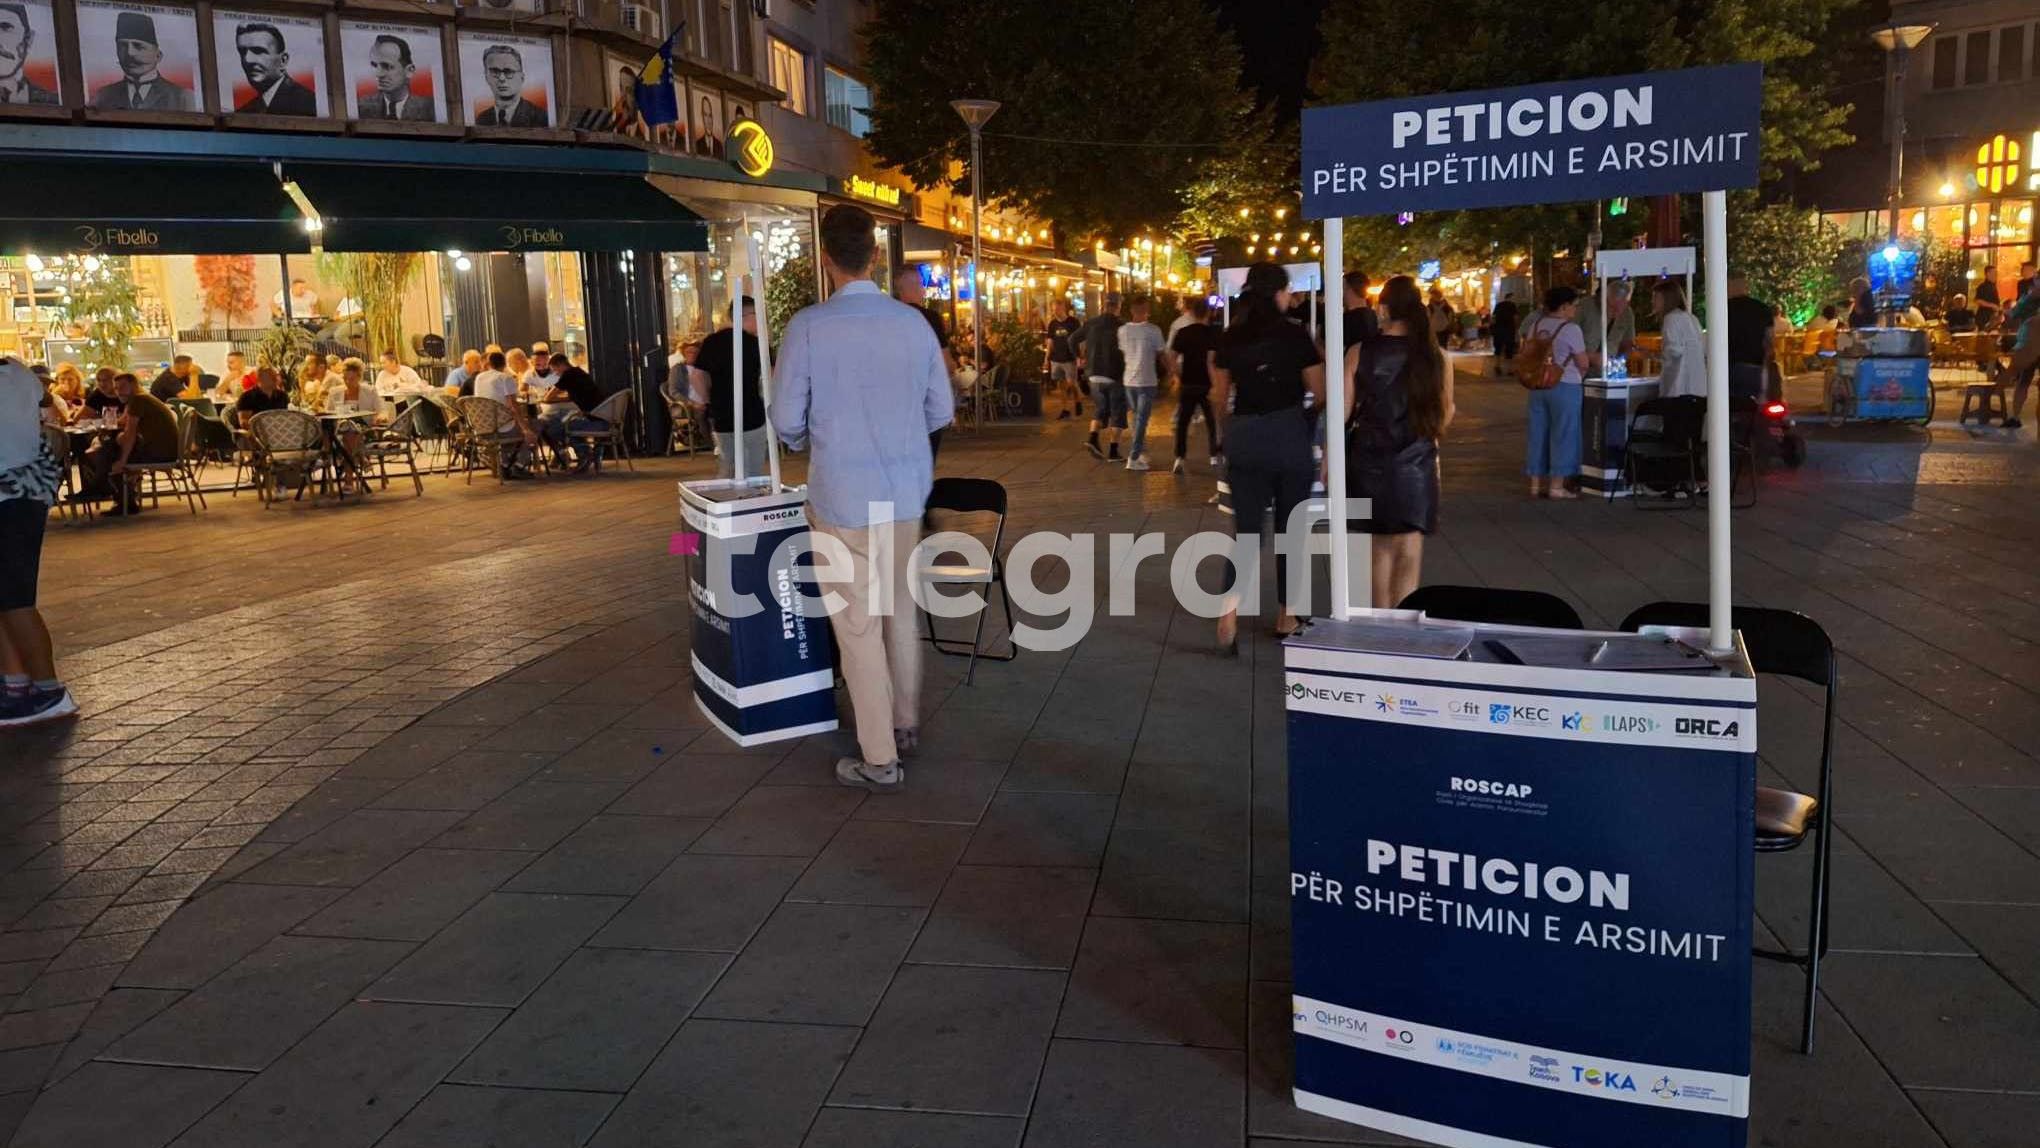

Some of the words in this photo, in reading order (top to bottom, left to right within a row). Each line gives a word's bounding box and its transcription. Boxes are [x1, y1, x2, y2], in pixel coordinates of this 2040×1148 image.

[1392, 85, 1653, 149] PETICION
[1313, 163, 1367, 195] PËR
[1379, 150, 1554, 190] SHPËTIMIN
[1568, 146, 1584, 174] E
[1599, 131, 1748, 172] ARSIMIT
[106, 228, 158, 245] Fibello
[523, 227, 563, 243] Fibello
[763, 510, 799, 521] ROSCAP
[777, 568, 795, 640] PETICION
[1513, 706, 1549, 720] KEC
[1562, 712, 1592, 732] KYC
[1675, 717, 1738, 737] ORCA
[1451, 777, 1532, 798] ROSCAP
[1367, 839, 1630, 910] PETICION
[1291, 871, 1343, 905] PËR
[1355, 885, 1530, 938] SHPËTIMIN
[1545, 916, 1561, 941] E
[1575, 920, 1726, 961] ARSIMIT
[1315, 1010, 1367, 1033] QHPSM
[1571, 1066, 1636, 1092] TOKA
